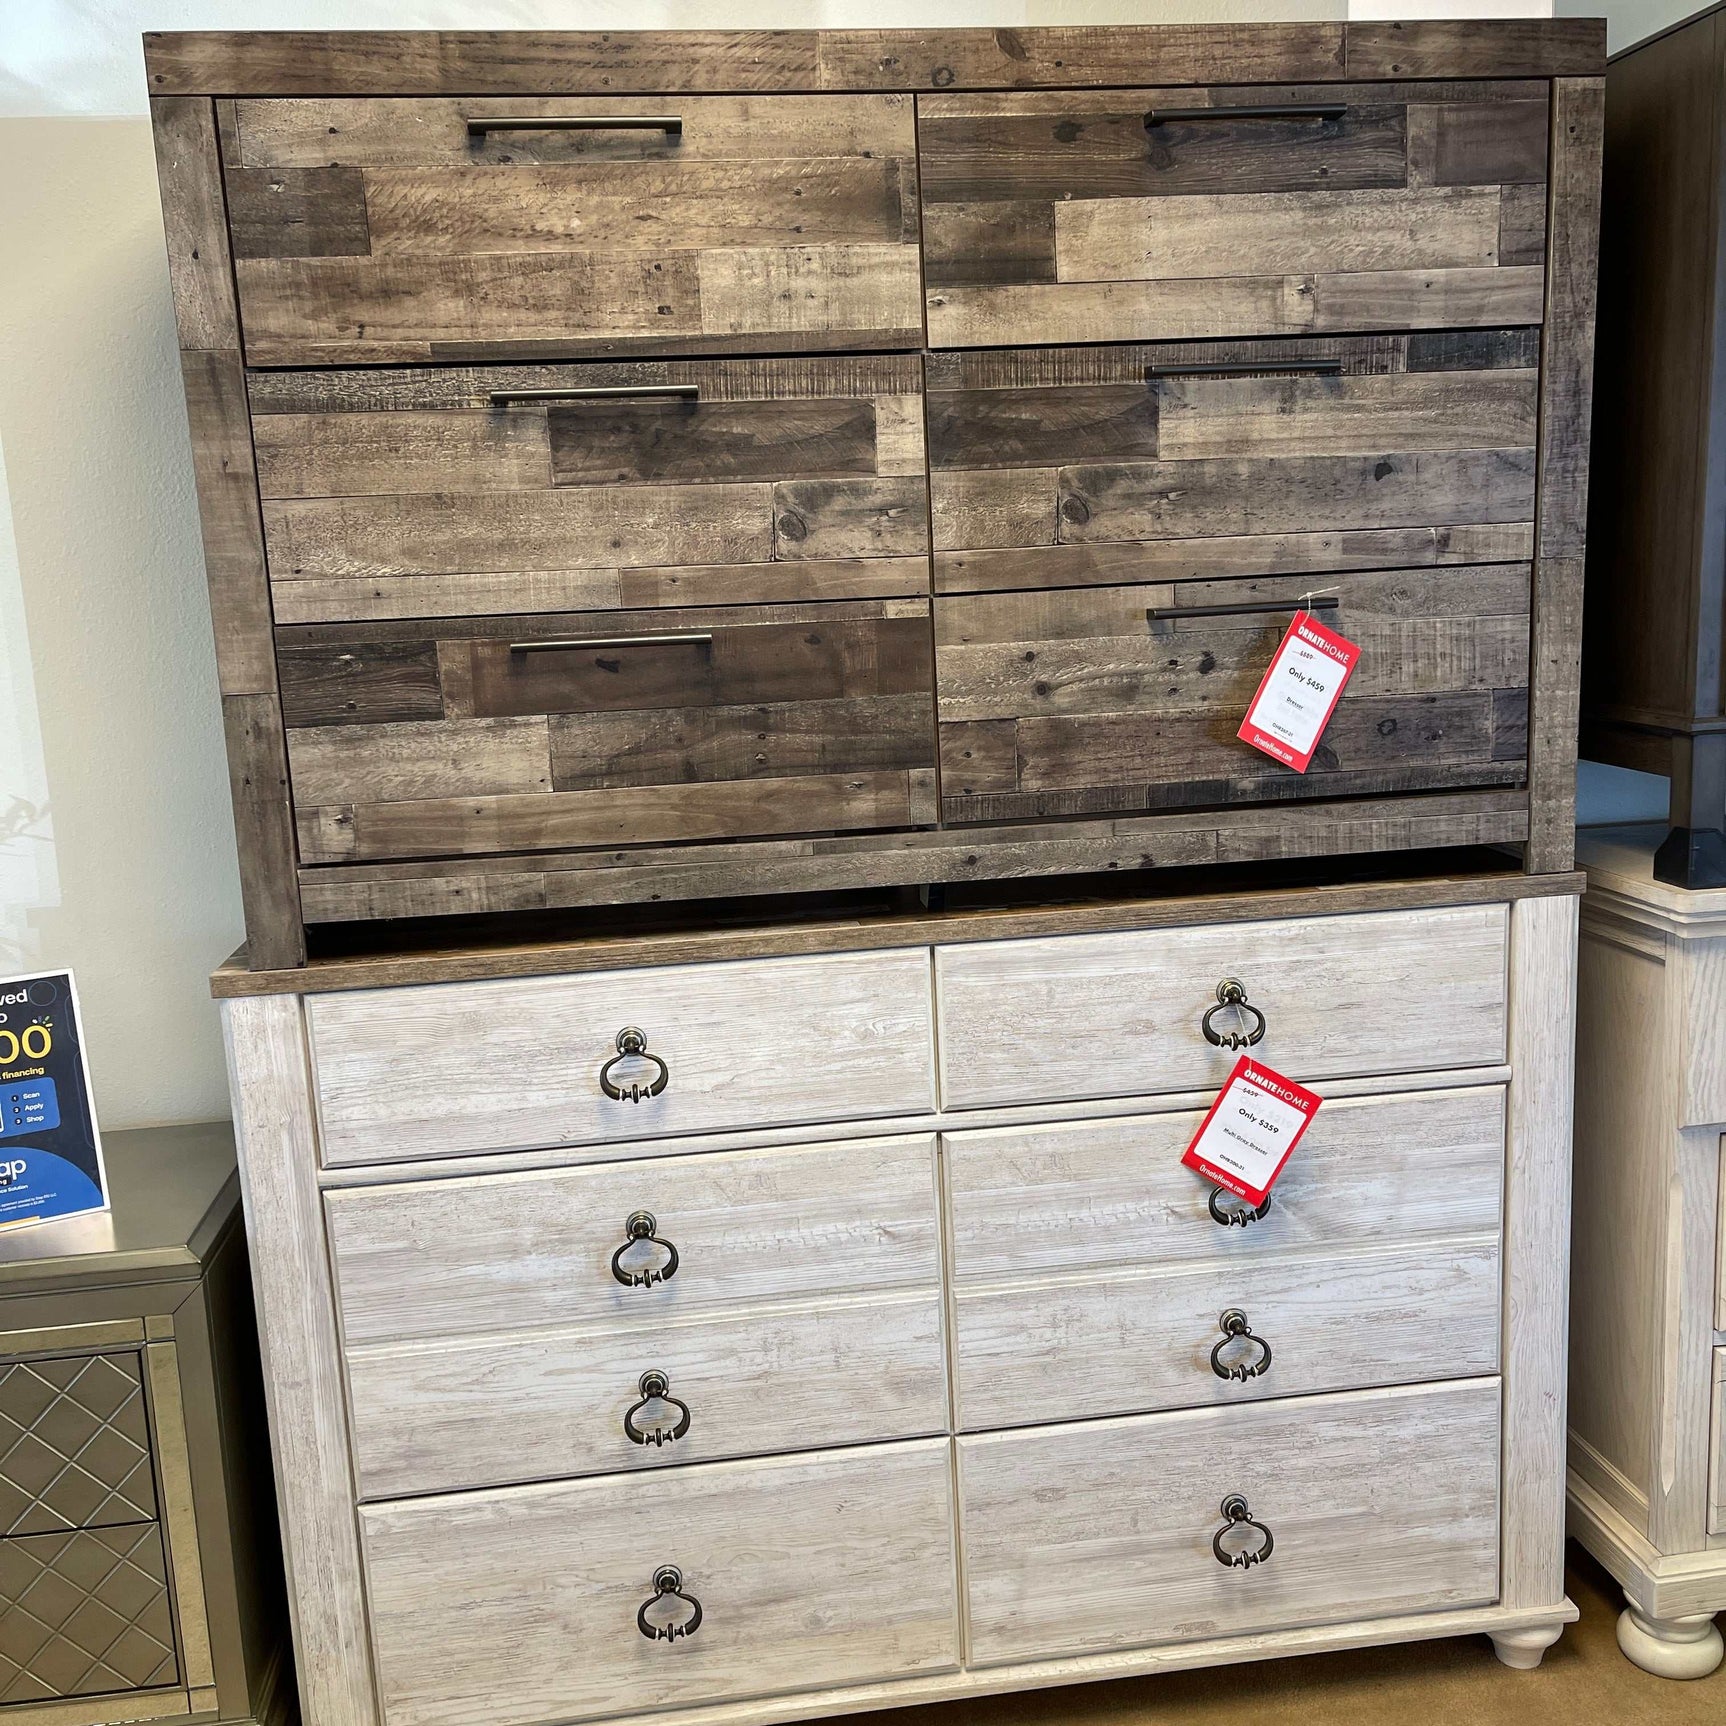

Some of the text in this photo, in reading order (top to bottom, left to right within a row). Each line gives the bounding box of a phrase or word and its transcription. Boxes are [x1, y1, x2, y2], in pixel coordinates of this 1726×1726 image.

[1288, 667, 1325, 693] Only $459
[1286, 696, 1304, 711] Dresser
[1253, 734, 1293, 762] OrnateHome.com
[2, 1067, 45, 1080] financing
[22, 1092, 40, 1100] Scan
[24, 1103, 44, 1112] Apply
[26, 1115, 44, 1123] Shop
[1238, 1108, 1280, 1135] Only $359
[1223, 1127, 1237, 1139] Multi
[0, 1159, 27, 1180] ap
[1199, 1164, 1246, 1196] OrnateHome.com
